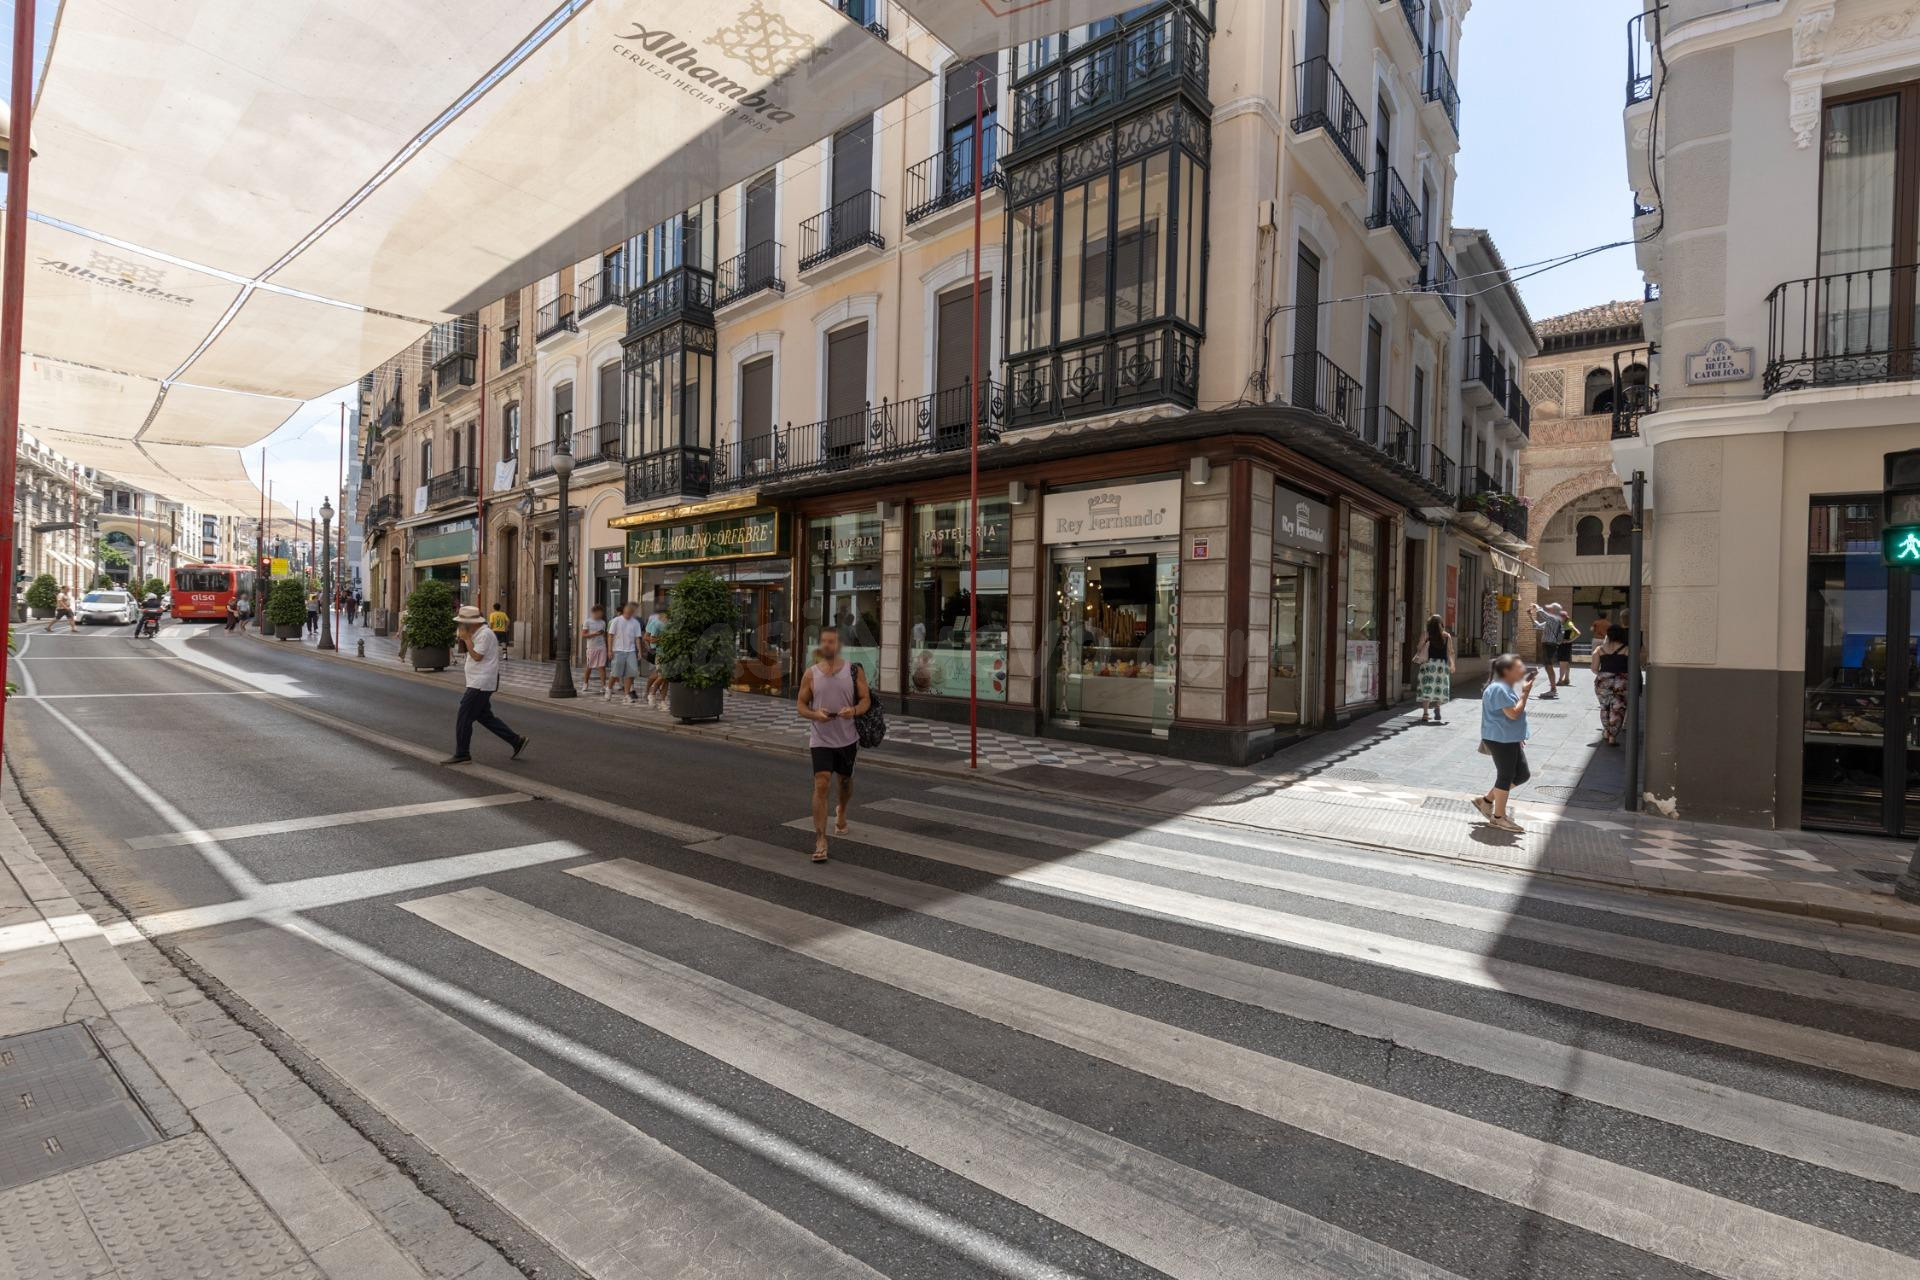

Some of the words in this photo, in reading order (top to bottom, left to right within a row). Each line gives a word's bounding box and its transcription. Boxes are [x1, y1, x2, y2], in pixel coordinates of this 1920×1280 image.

[612, 43, 671, 81] CERVEZA
[672, 78, 715, 106] HECHA
[715, 100, 738, 117] SIN
[738, 114, 774, 134] PRISA
[614, 22, 795, 125] Alhambra
[33, 257, 195, 304] Alhambra
[671, 532, 711, 551] MORENO
[717, 524, 769, 545] ORFEBRE
[1056, 517, 1083, 536] Rey
[1088, 509, 1163, 531] Fernando
[1281, 514, 1294, 537] Rey
